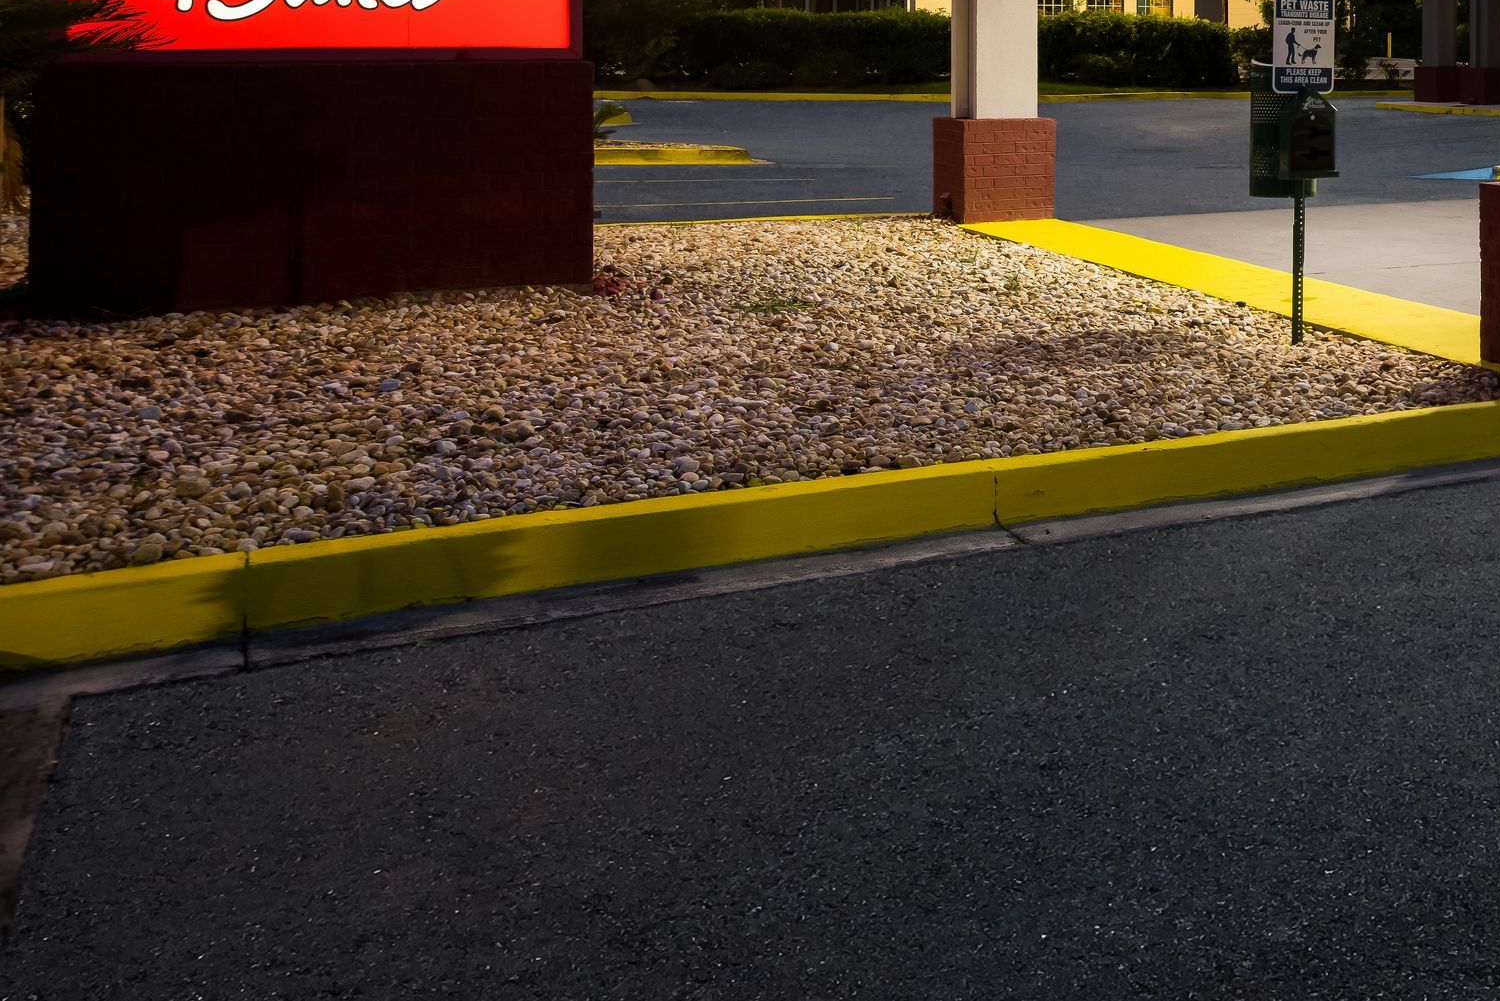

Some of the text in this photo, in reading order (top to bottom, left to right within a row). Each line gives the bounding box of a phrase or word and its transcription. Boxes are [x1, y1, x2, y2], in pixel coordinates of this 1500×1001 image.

[1280, 0, 1329, 11] PET WASTE
[1281, 10, 1329, 19] TRANSMITS DISEASE
[1286, 68, 1307, 76] PLEASE
[1280, 76, 1293, 84] THIS
[1294, 76, 1309, 84] AREA
